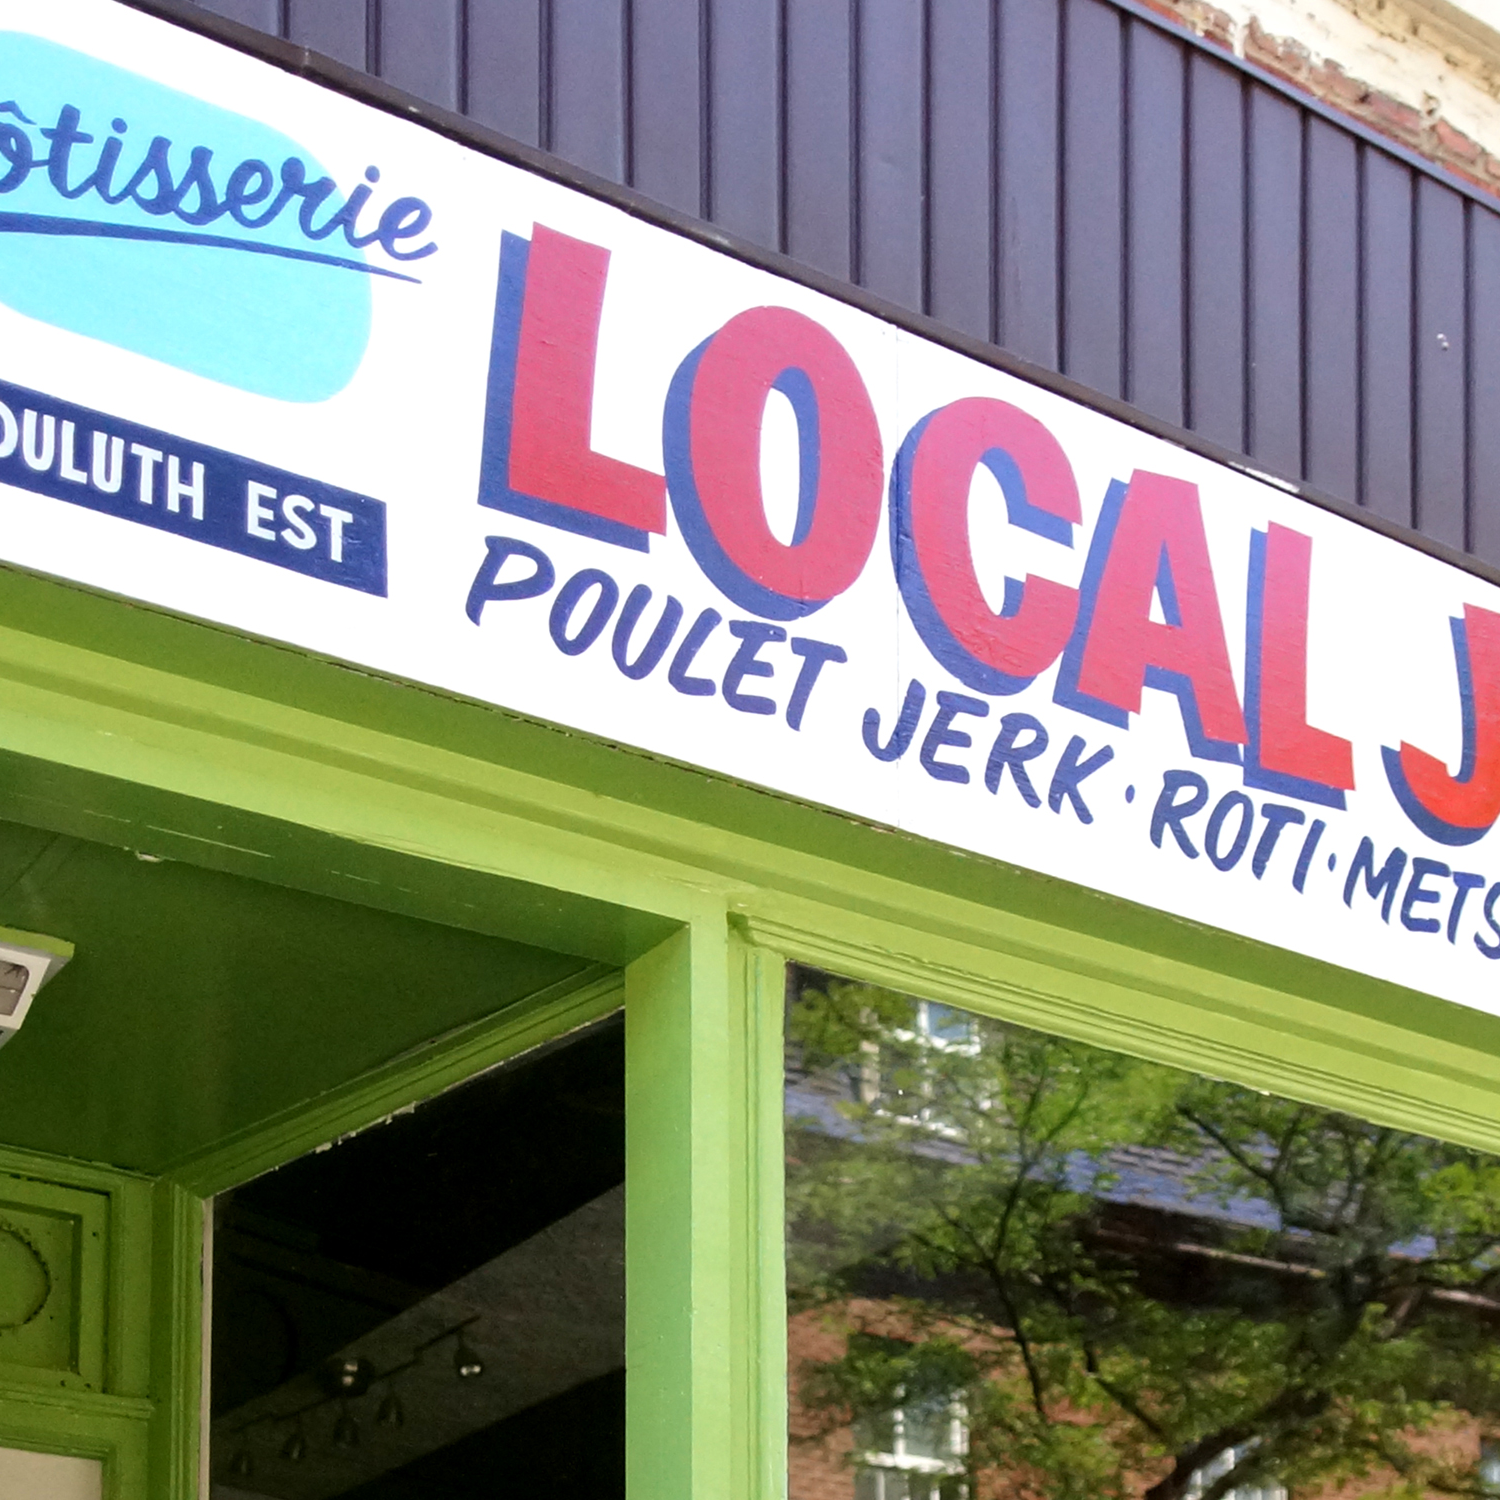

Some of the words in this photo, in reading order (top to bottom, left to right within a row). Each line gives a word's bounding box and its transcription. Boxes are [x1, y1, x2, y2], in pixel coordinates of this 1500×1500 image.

[245, 481, 354, 564] EST
[477, 221, 1356, 811] LOCAL
[465, 535, 848, 732] POULET
[862, 679, 1115, 825] JERK
[1149, 769, 1328, 894] ROTI
